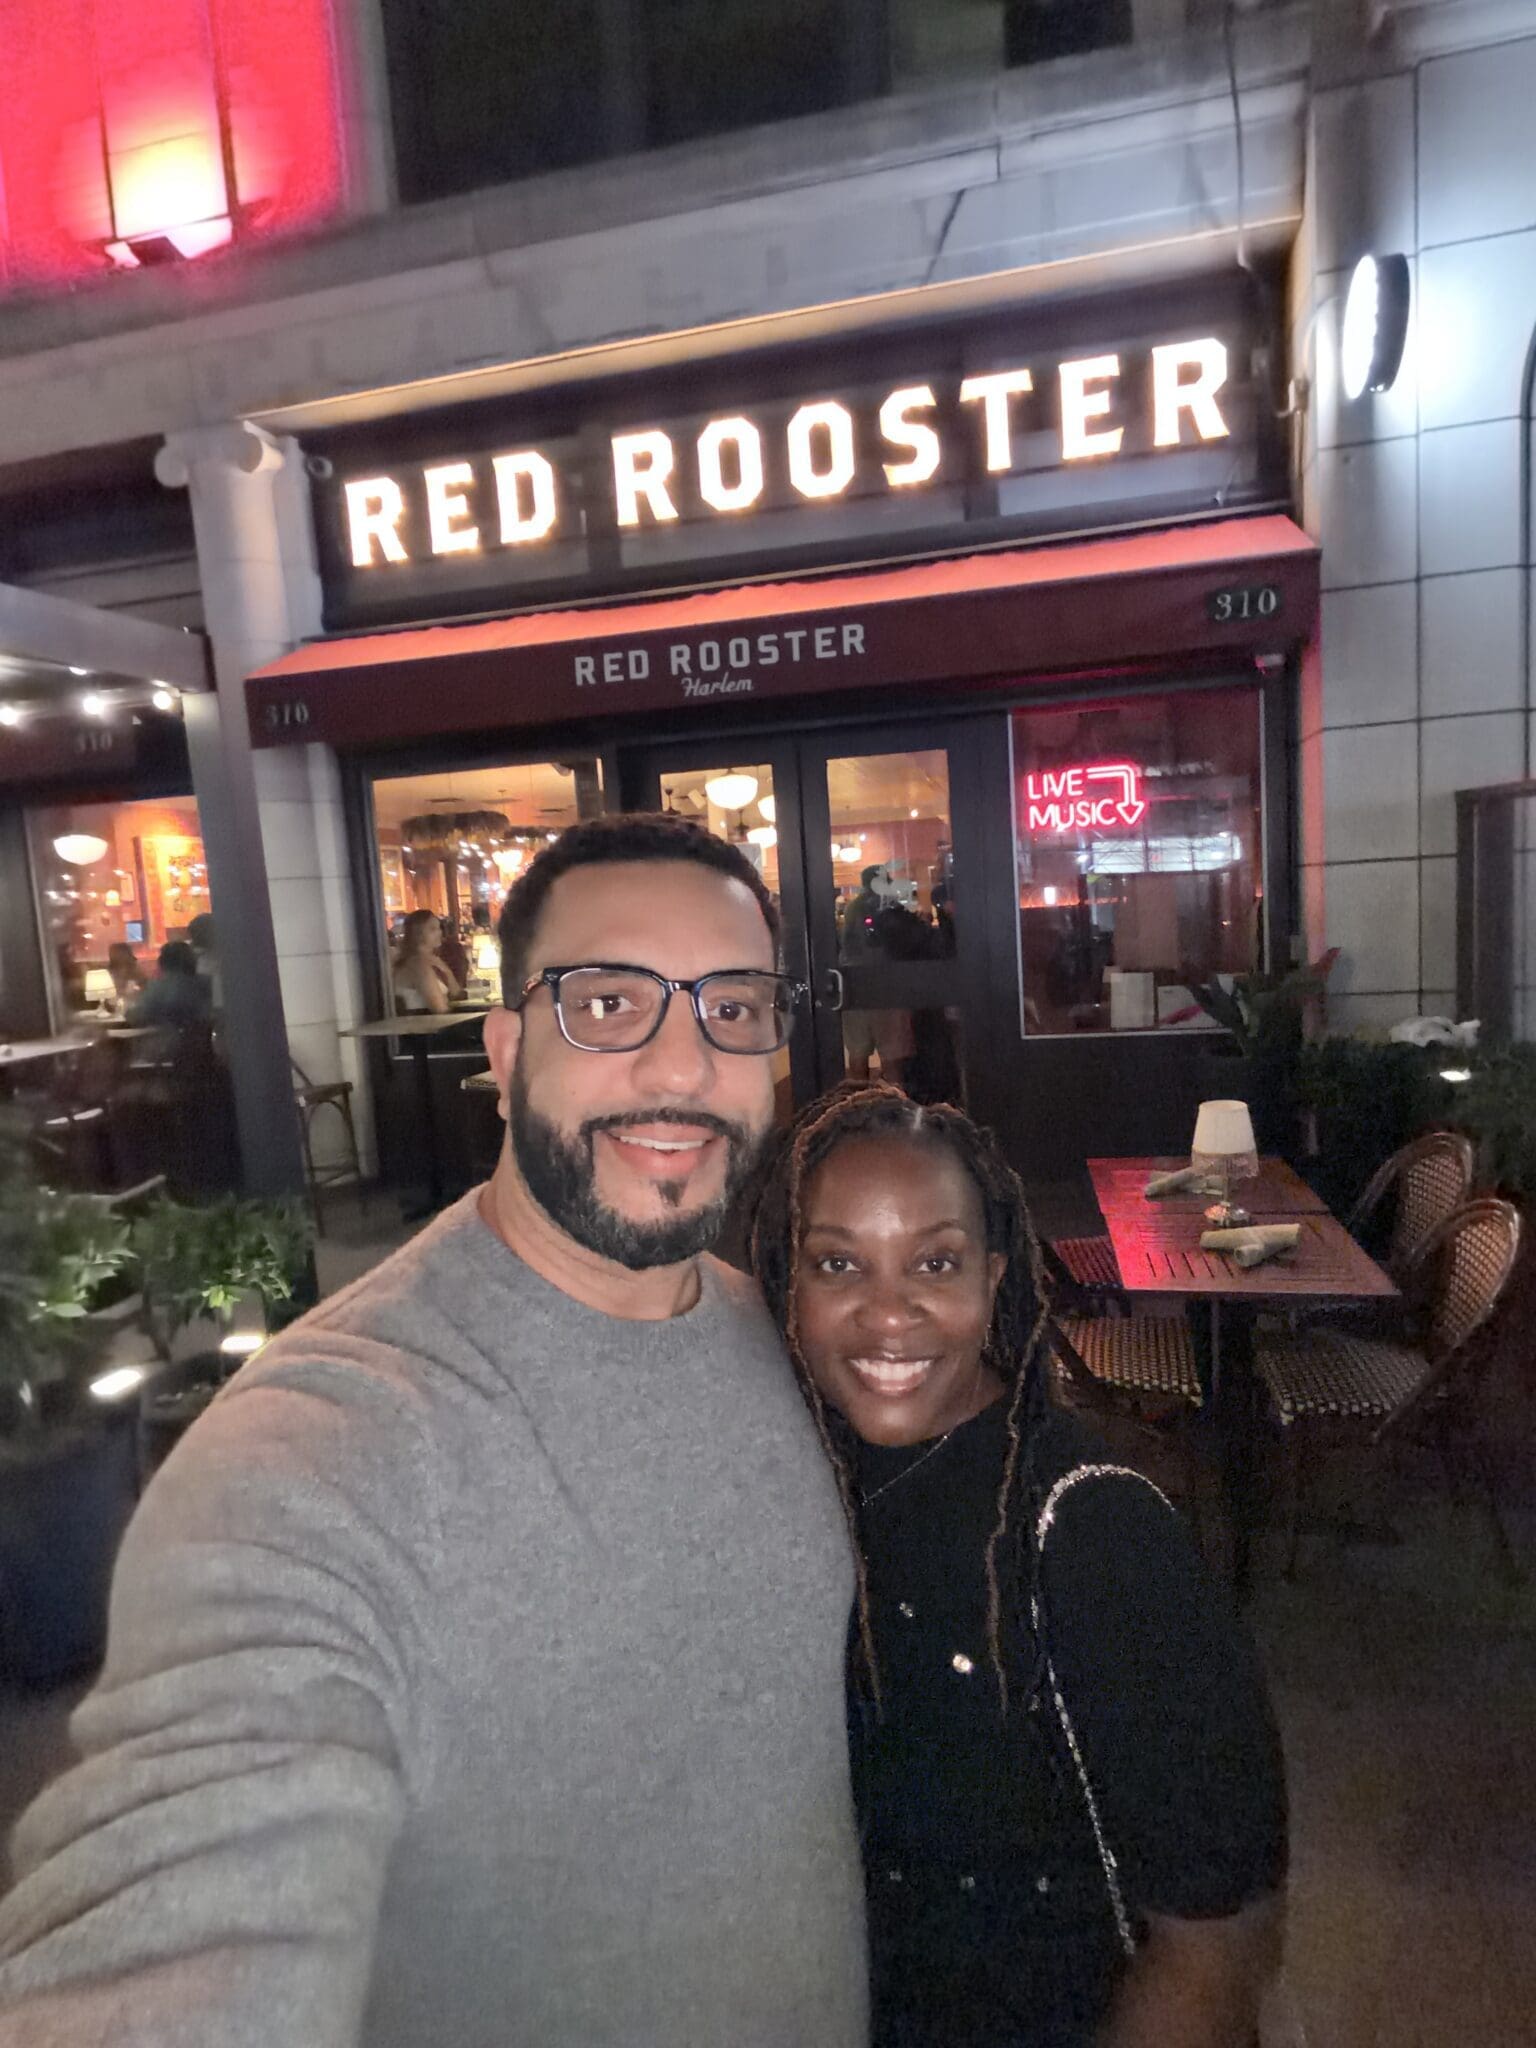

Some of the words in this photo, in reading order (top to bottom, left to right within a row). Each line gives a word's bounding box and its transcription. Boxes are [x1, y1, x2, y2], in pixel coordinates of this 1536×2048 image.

[344, 451, 557, 568] RED
[611, 337, 1231, 527] ROOSTER
[1214, 588, 1278, 621] 310
[574, 649, 650, 687] RED
[670, 623, 866, 675] ROOSTER
[681, 671, 754, 698] Harlem
[1027, 768, 1084, 800] LIVE
[1028, 798, 1117, 831] MUSIC
